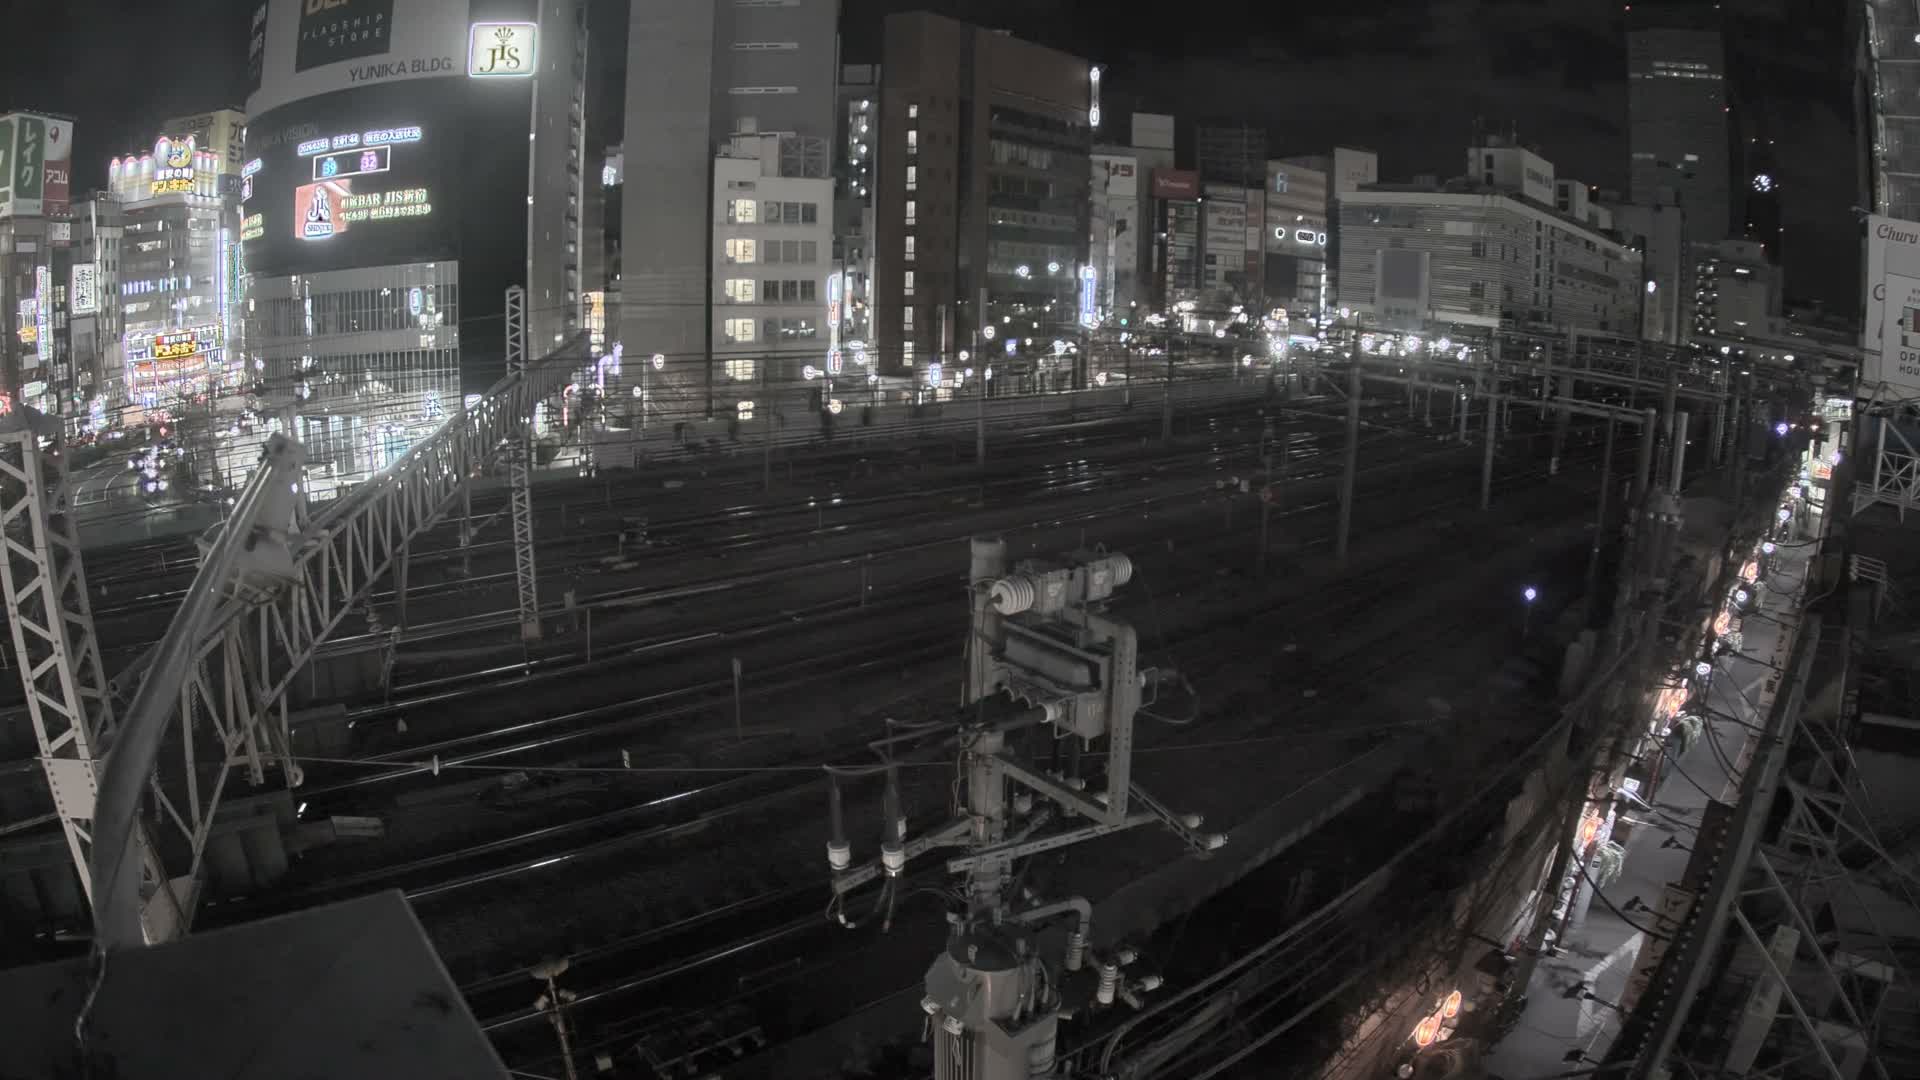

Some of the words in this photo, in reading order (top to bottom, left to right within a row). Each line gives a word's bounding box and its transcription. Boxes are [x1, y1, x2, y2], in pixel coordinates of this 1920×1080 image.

[328, 27, 383, 47] STORE
[350, 62, 407, 81] YUNIKA
[21, 120, 37, 188] レイク
[46, 168, 68, 185] アコム
[1876, 223, 1919, 244] Churu
